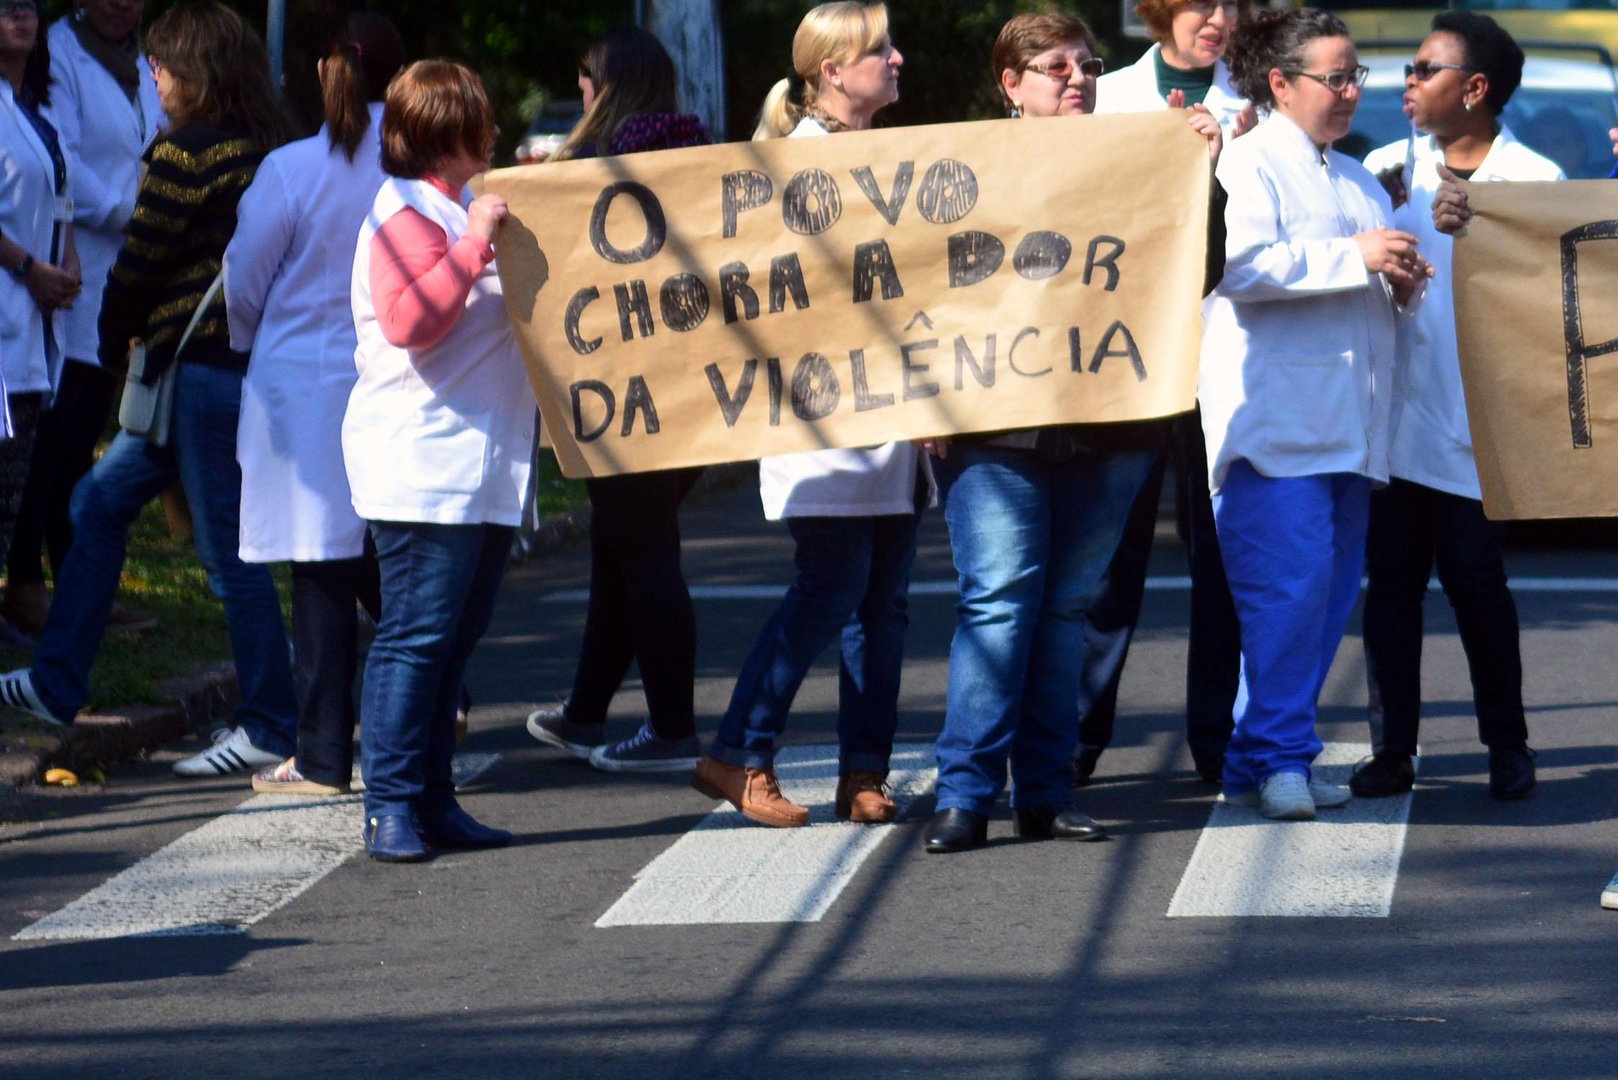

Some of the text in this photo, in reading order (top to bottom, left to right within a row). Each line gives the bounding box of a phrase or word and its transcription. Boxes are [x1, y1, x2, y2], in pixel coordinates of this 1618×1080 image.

[590, 157, 978, 265] O POVO
[564, 230, 1126, 356] CHORA A DOR
[569, 310, 1149, 444] DA VIOLÊNCIA
